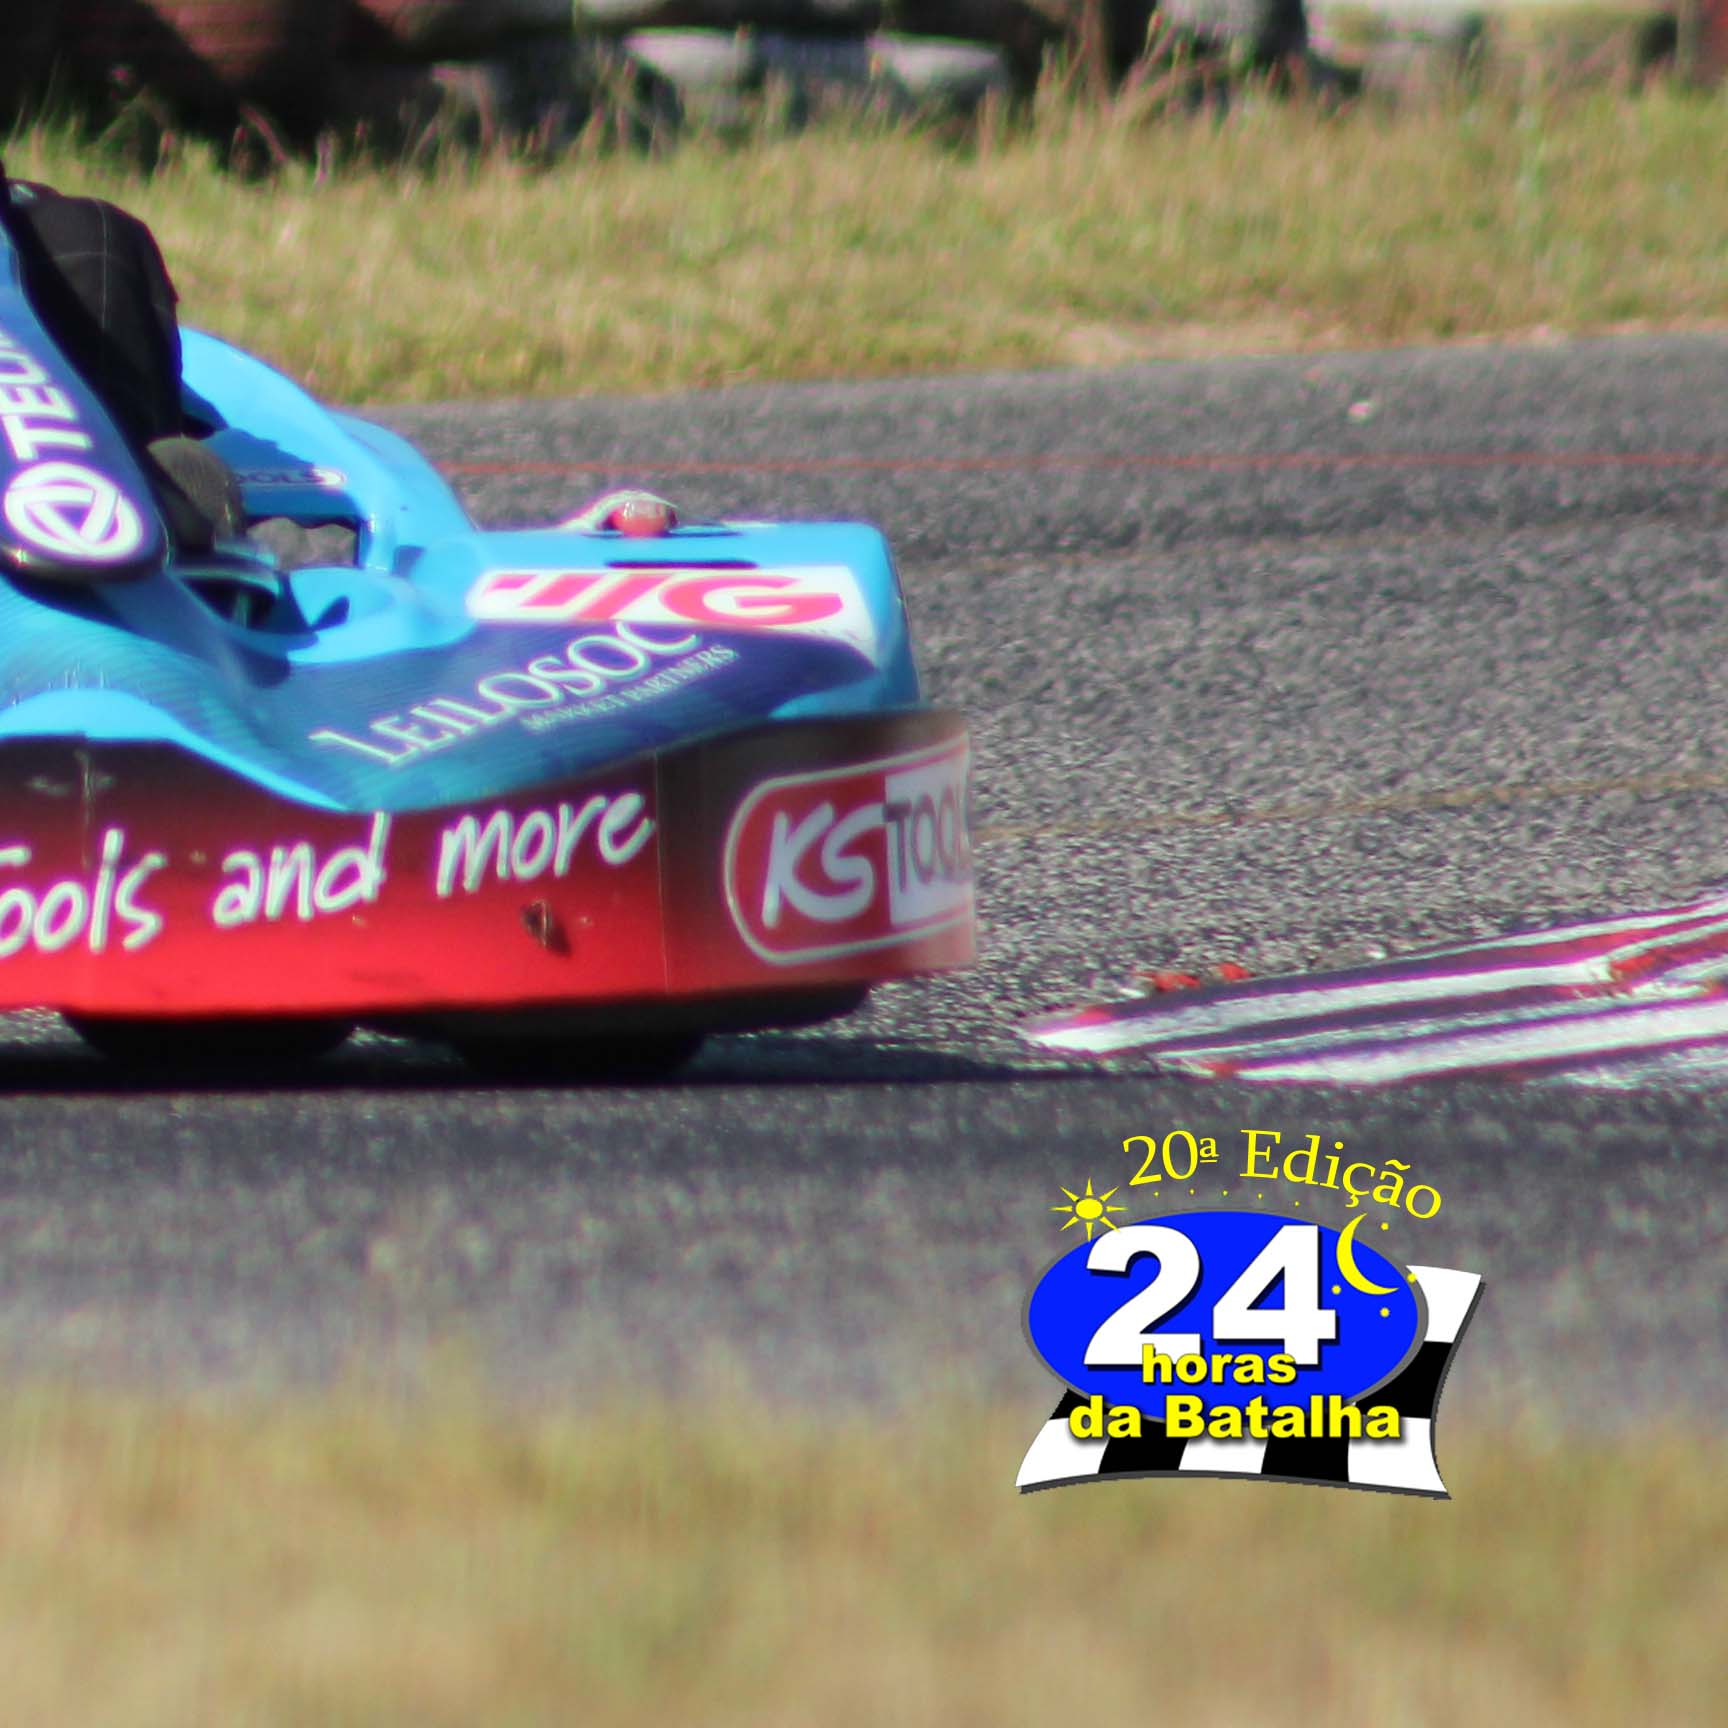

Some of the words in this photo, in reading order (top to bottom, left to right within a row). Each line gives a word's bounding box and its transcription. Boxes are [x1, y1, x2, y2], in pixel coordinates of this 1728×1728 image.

[211, 810, 391, 928] and
[434, 790, 658, 898] more
[760, 799, 886, 930] KS
